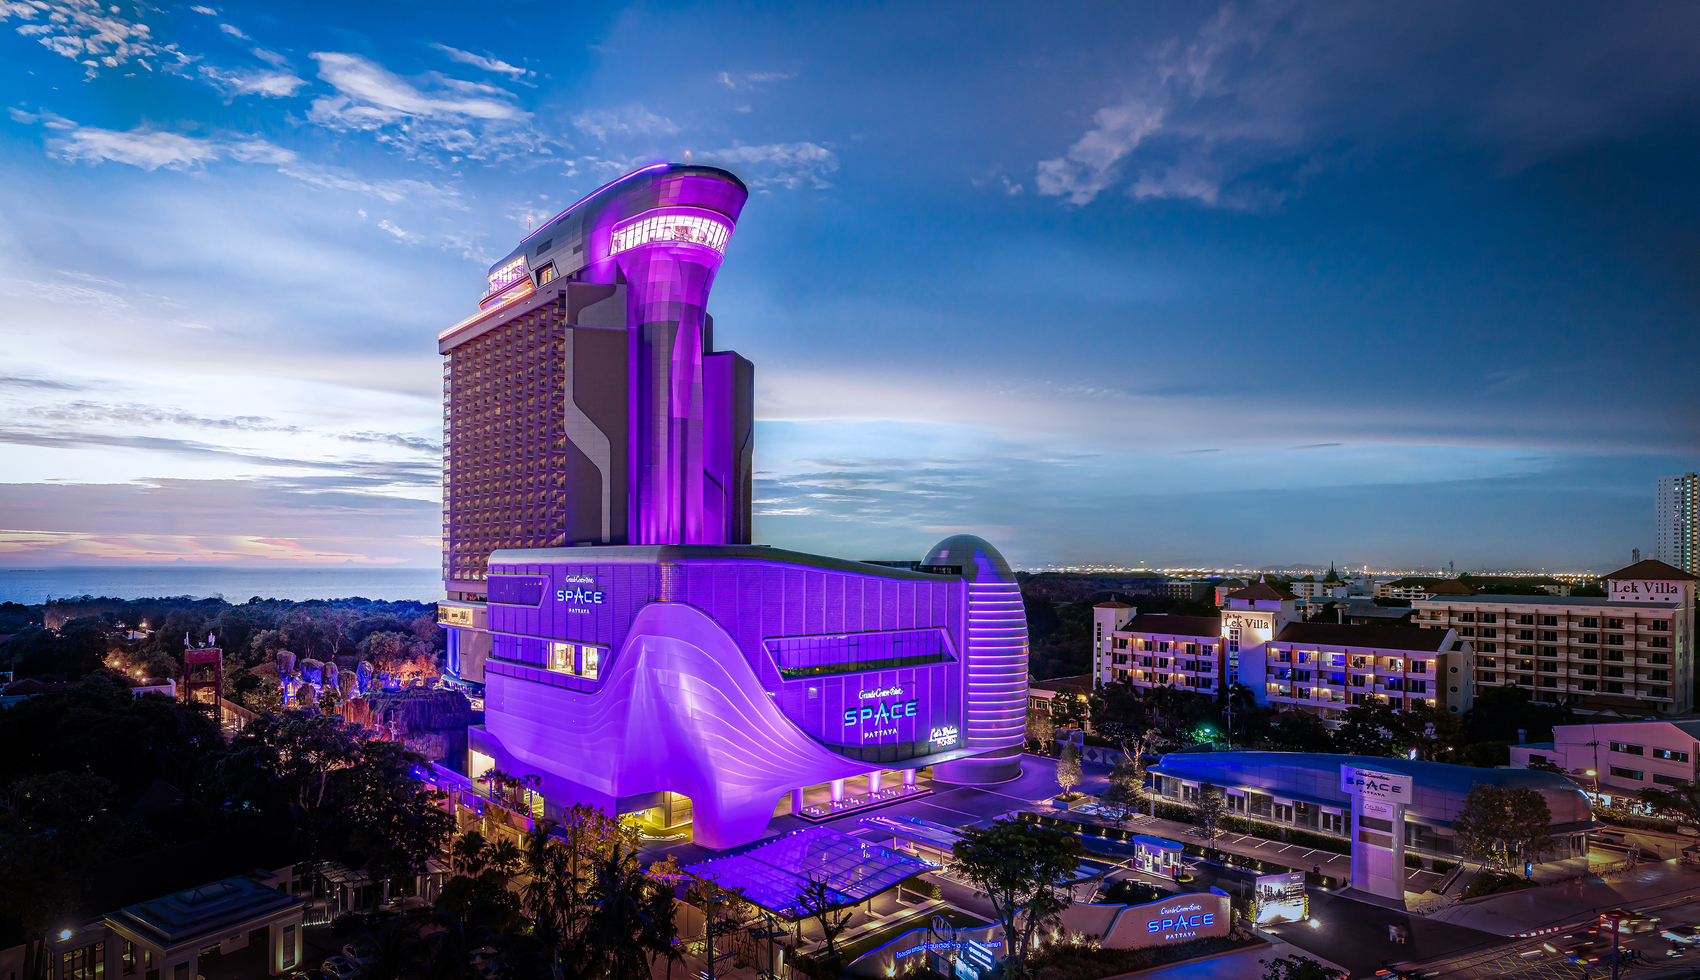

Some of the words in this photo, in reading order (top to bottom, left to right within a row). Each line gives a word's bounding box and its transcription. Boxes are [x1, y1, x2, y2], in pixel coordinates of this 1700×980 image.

[1612, 581, 1639, 593] Lek
[1643, 582, 1678, 594] Villa
[557, 587, 602, 604] SPACE
[1224, 617, 1243, 628] Lek
[1245, 619, 1269, 629] Villa
[844, 701, 917, 726] SPACE
[864, 728, 898, 739] PATTAYA
[1346, 777, 1402, 794] SPACE
[1148, 913, 1214, 933] SPACE
[1165, 931, 1196, 940] PATTAYA
